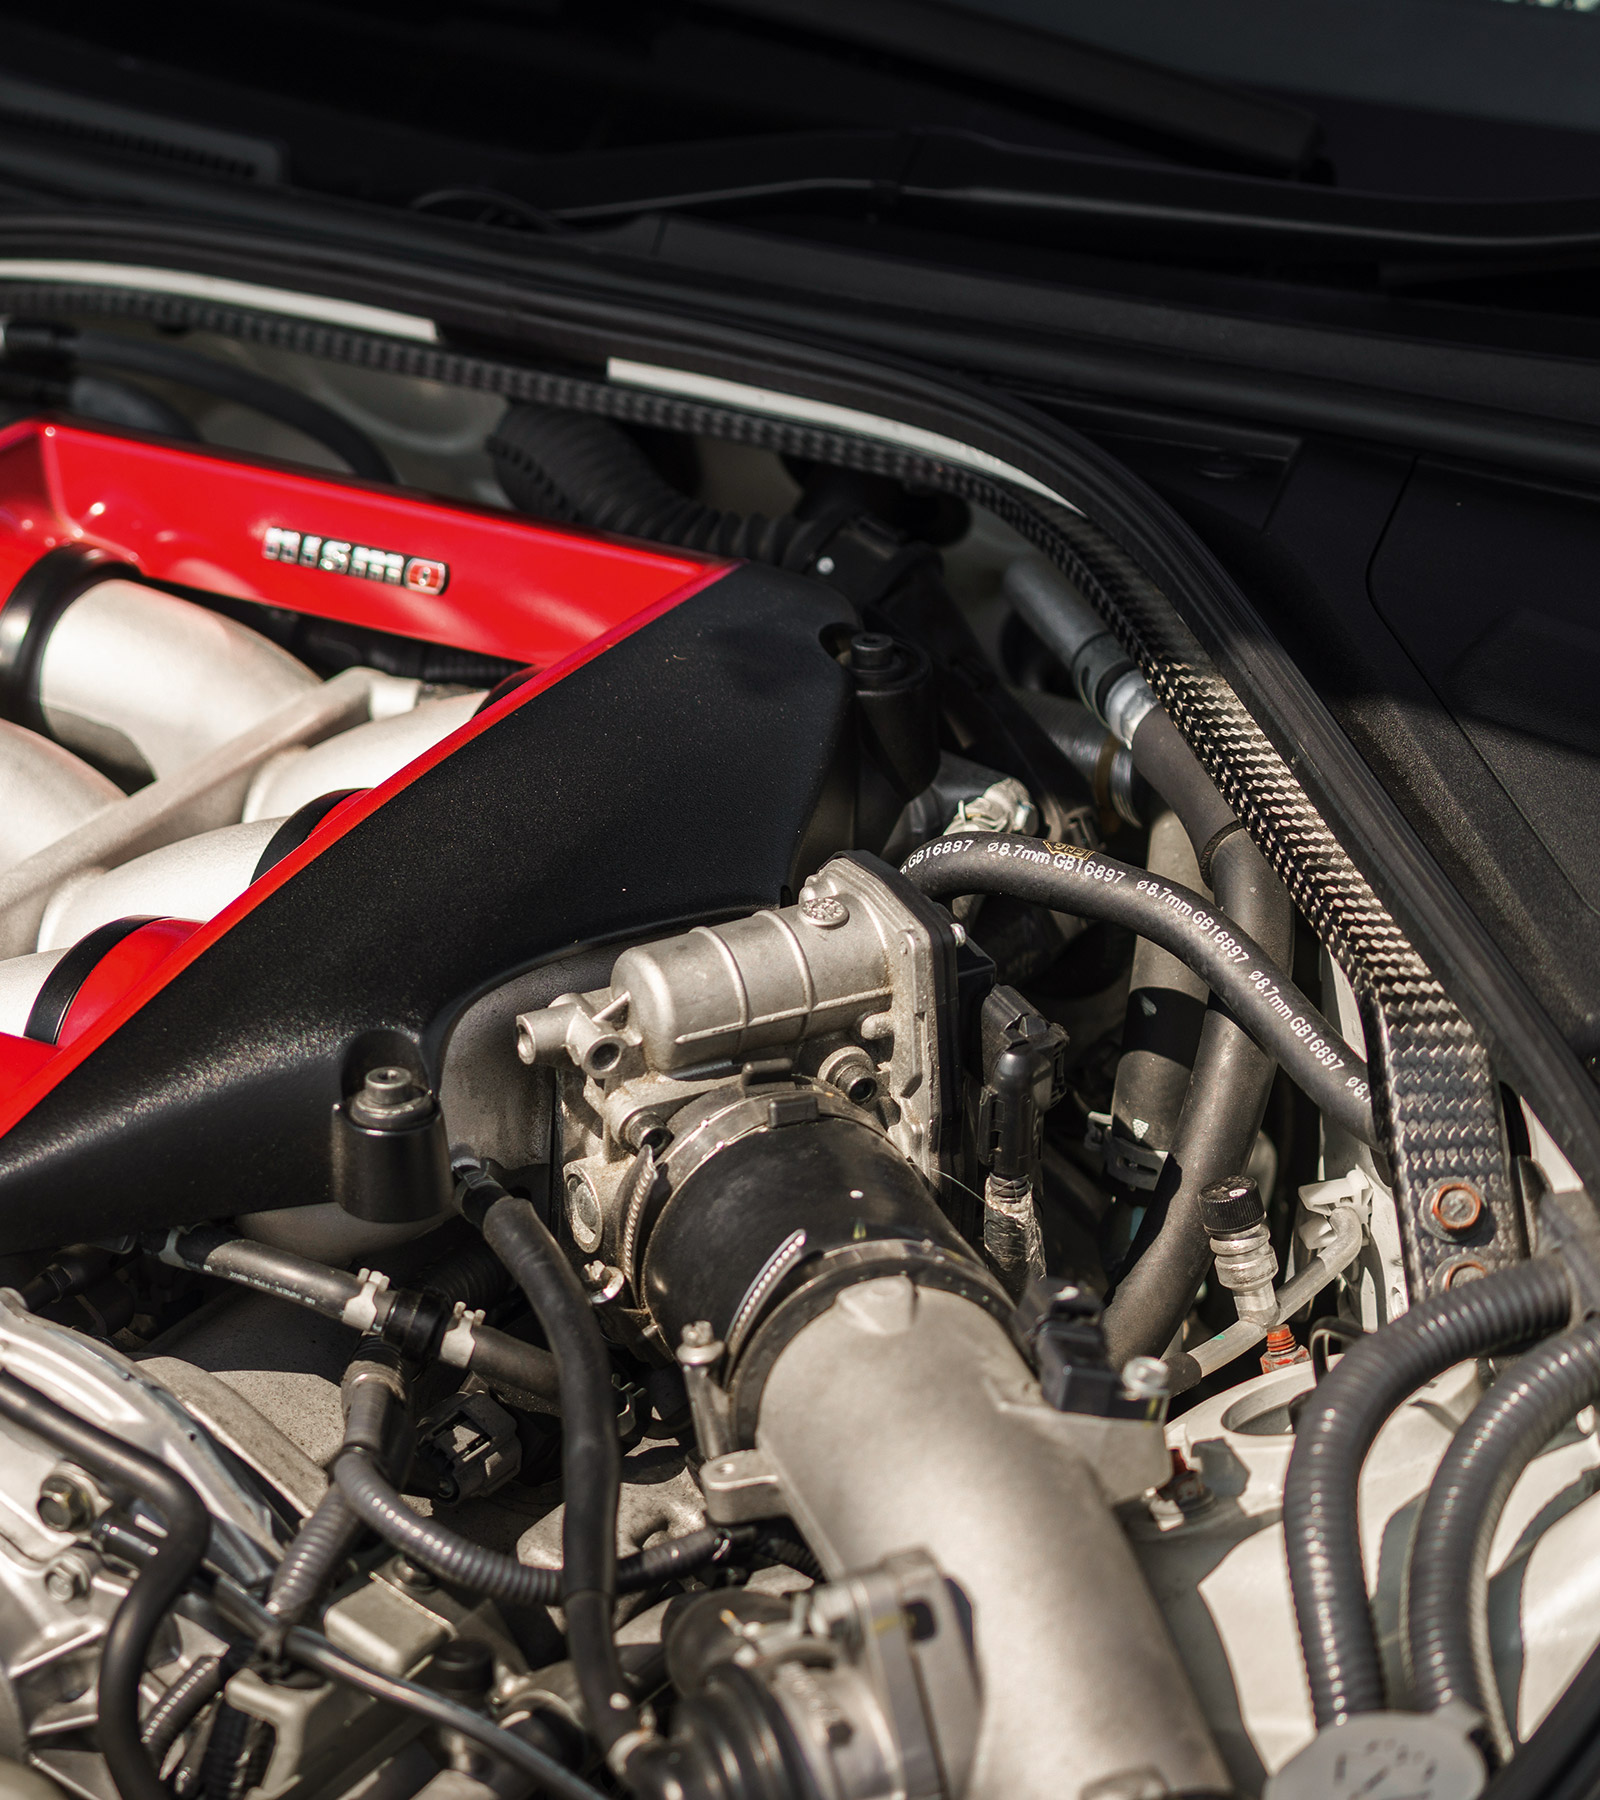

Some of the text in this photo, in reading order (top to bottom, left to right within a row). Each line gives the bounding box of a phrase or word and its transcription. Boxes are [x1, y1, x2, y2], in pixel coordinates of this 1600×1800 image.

[908, 839, 974, 868] GB16897
[1053, 853, 1127, 884] GB16897
[1192, 910, 1250, 965] GB16897
[1289, 1016, 1345, 1072] GB16897
